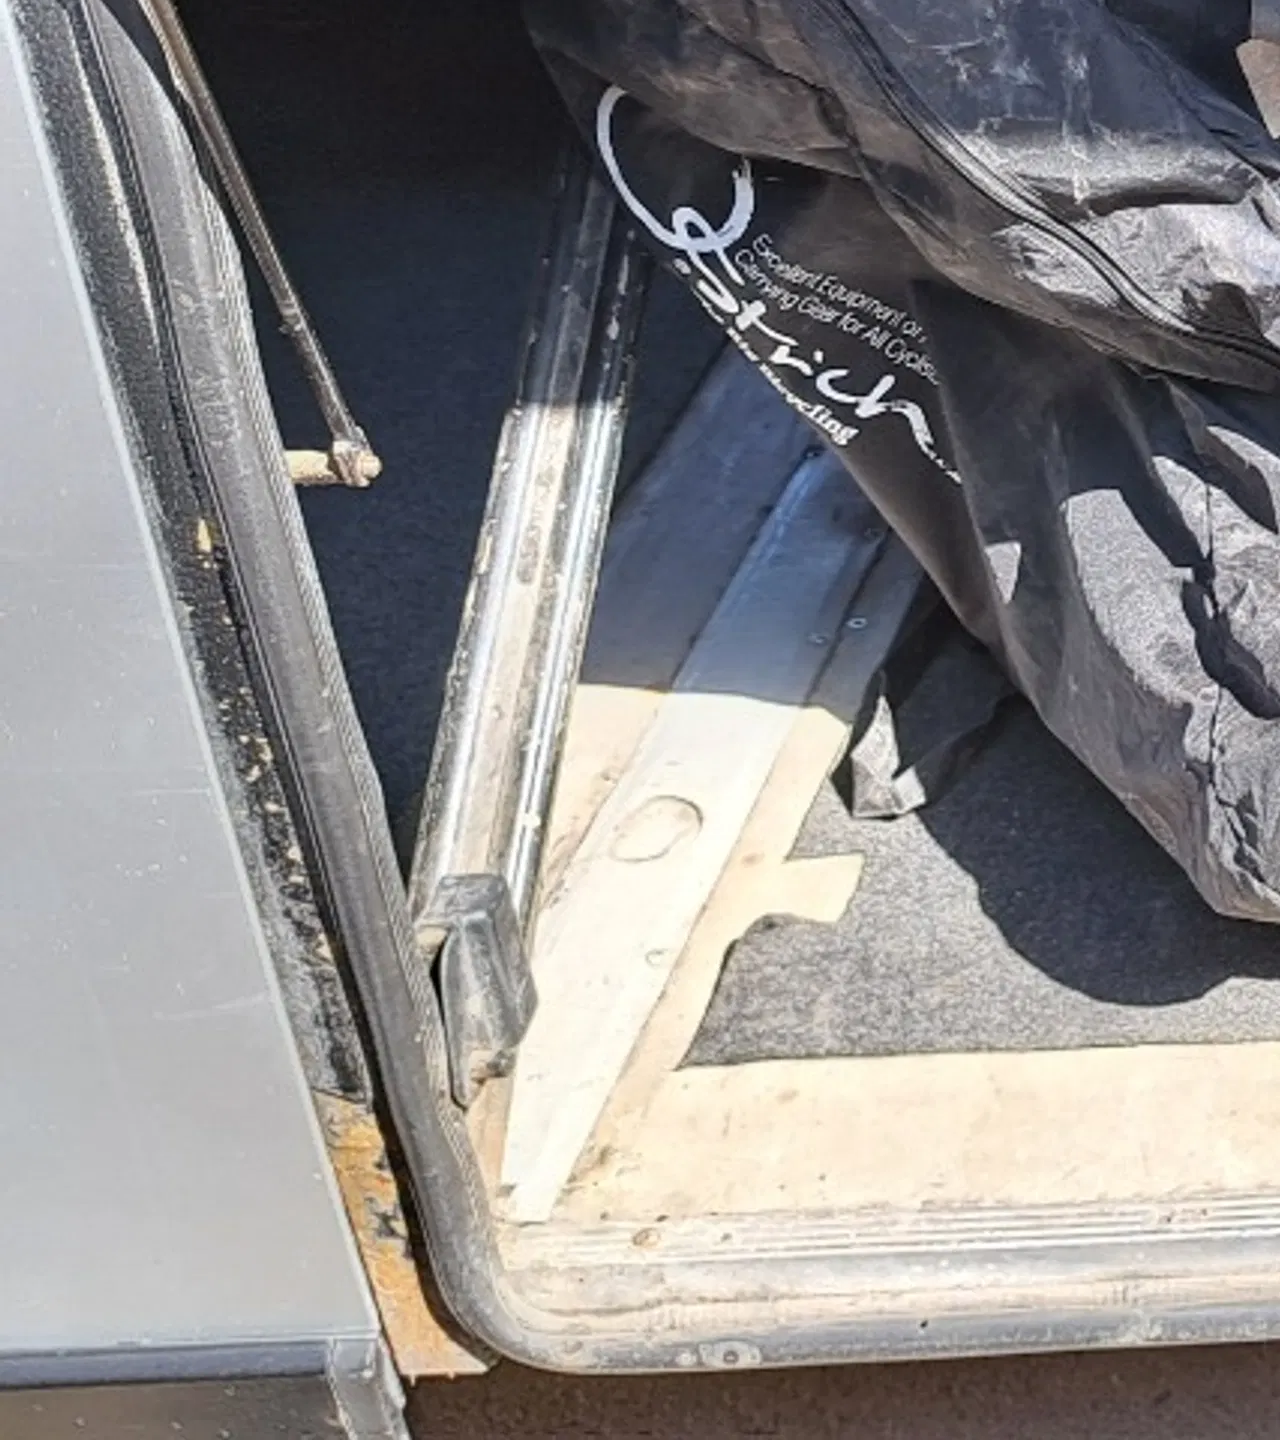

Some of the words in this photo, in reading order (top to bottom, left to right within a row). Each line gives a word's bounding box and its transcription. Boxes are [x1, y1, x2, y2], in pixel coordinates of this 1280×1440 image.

[797, 293, 844, 324] Gear
[836, 311, 871, 336] for
[859, 325, 894, 350] All
